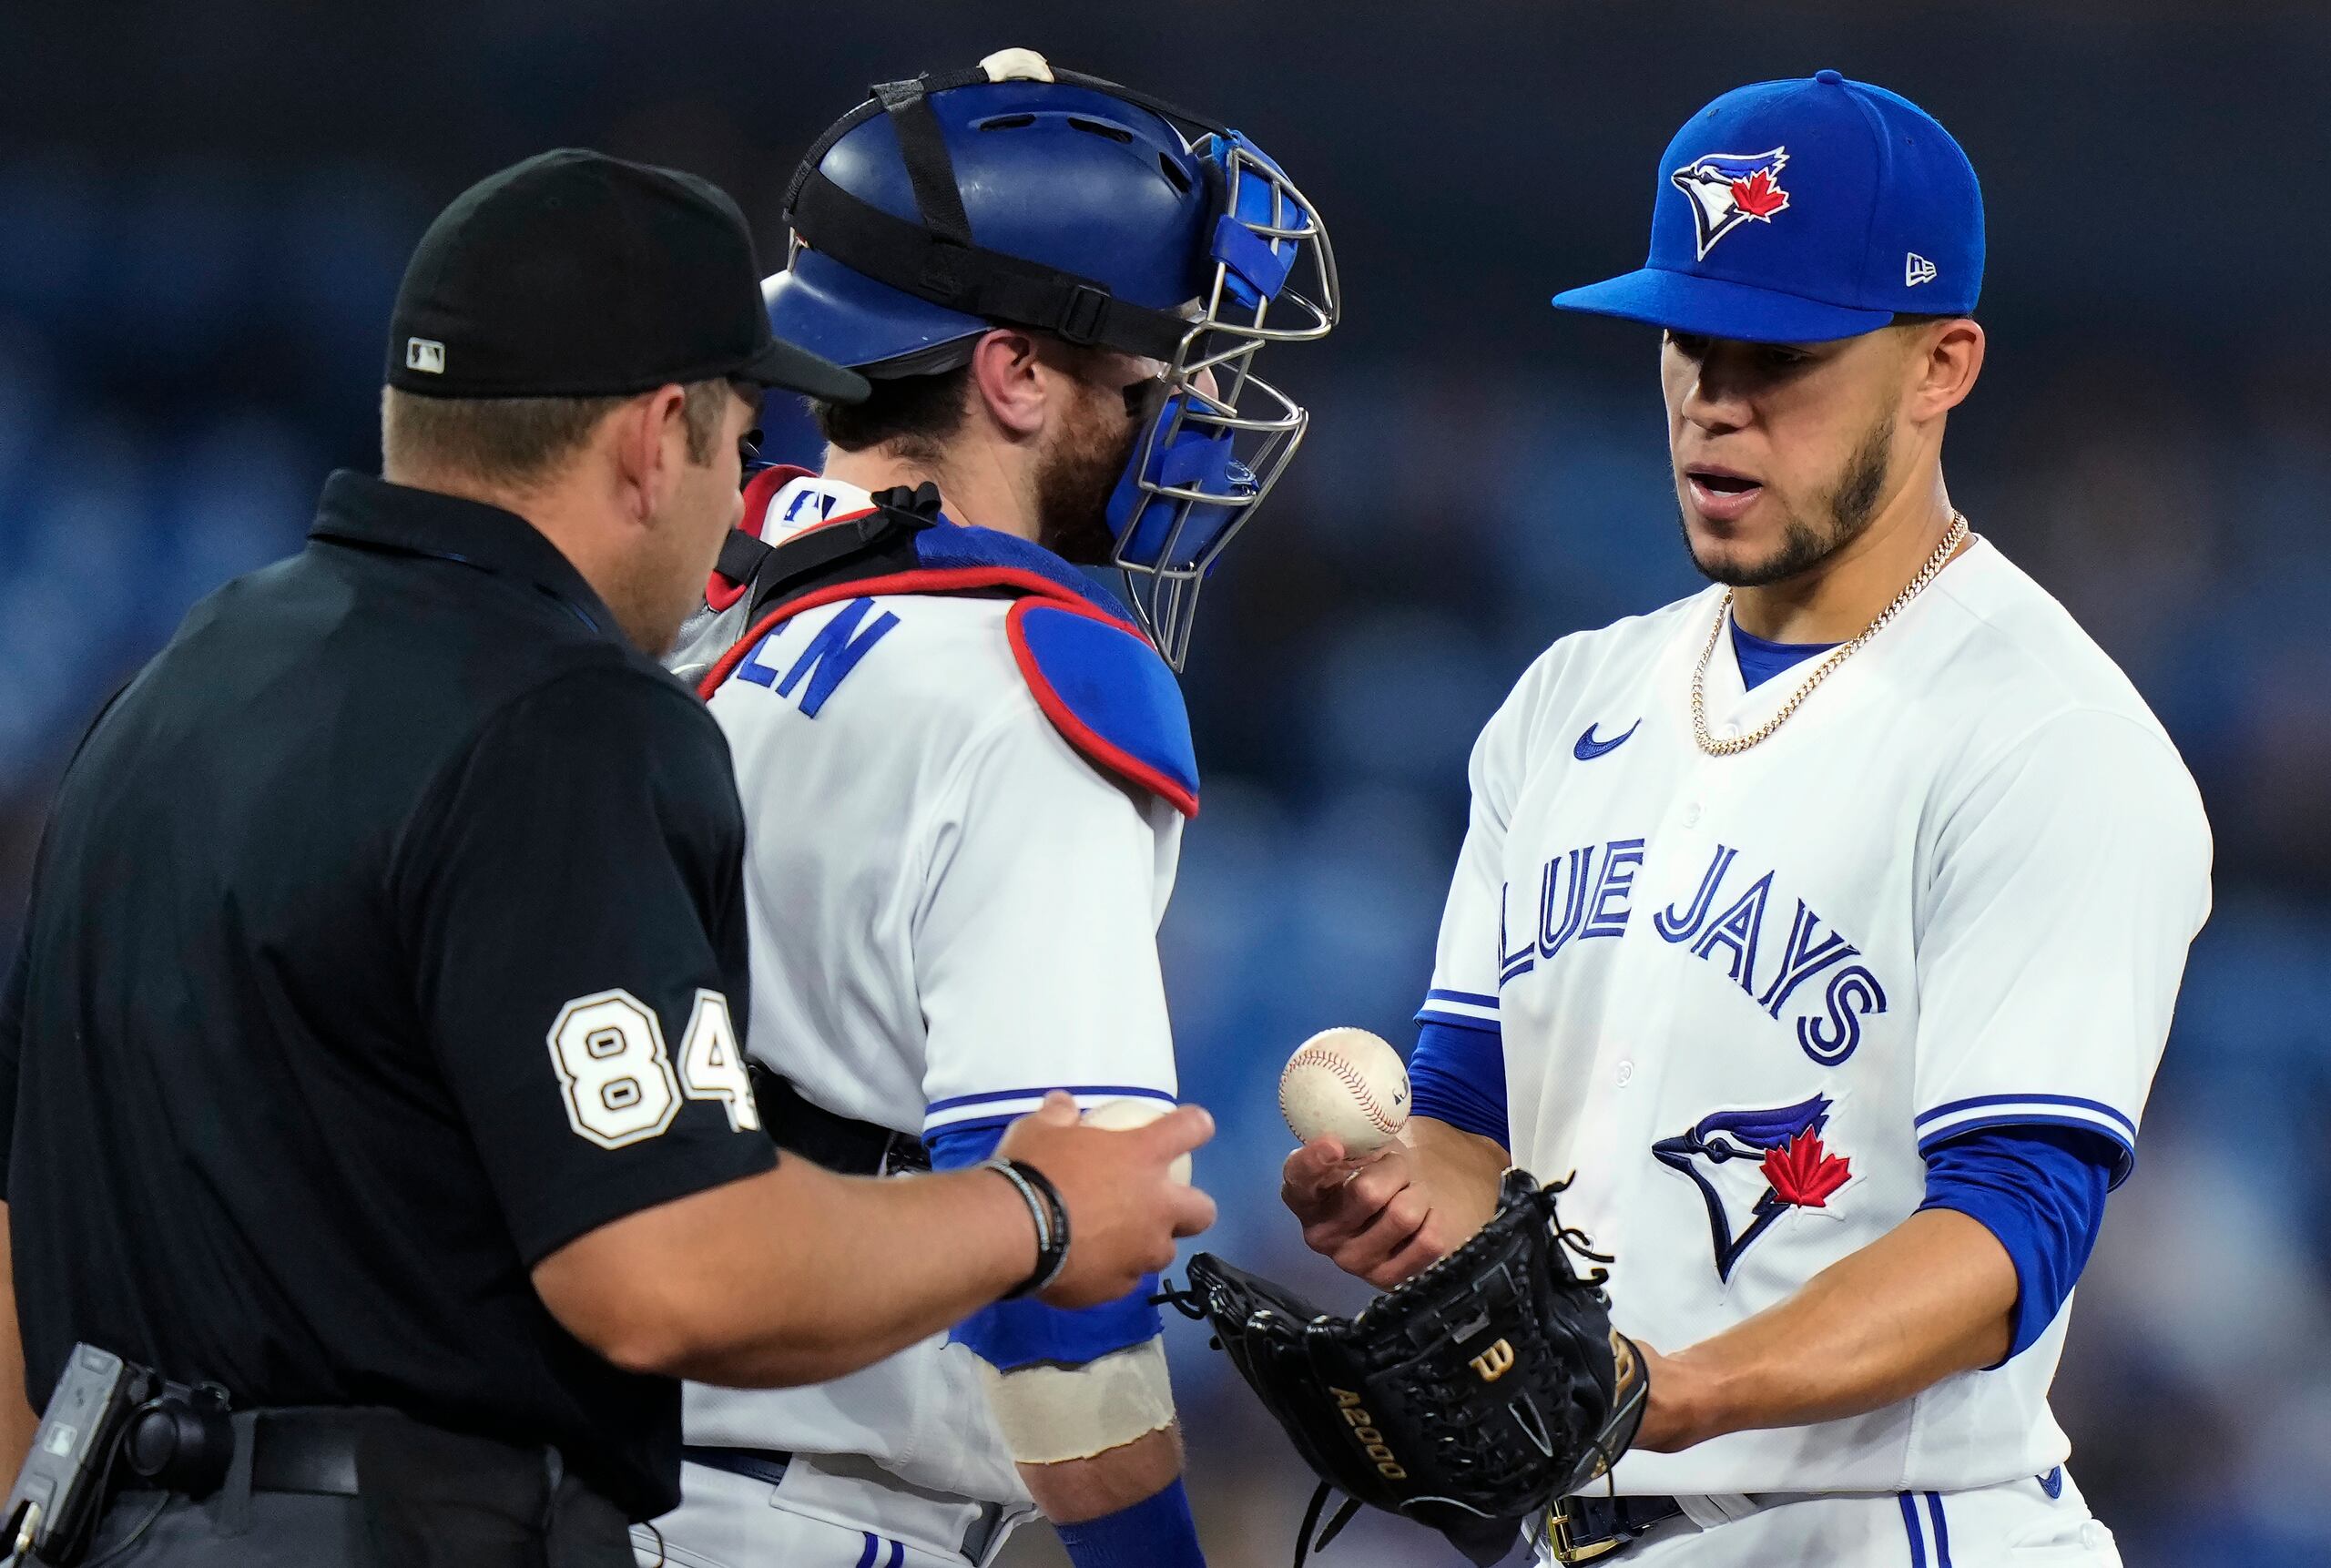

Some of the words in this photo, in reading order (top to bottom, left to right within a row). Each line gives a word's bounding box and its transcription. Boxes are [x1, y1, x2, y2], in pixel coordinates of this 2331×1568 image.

[728, 596, 901, 719] EN
[1653, 843, 1888, 1067] JAYS
[546, 987, 763, 1151] 84
[1328, 1385, 1408, 1481] A2000
